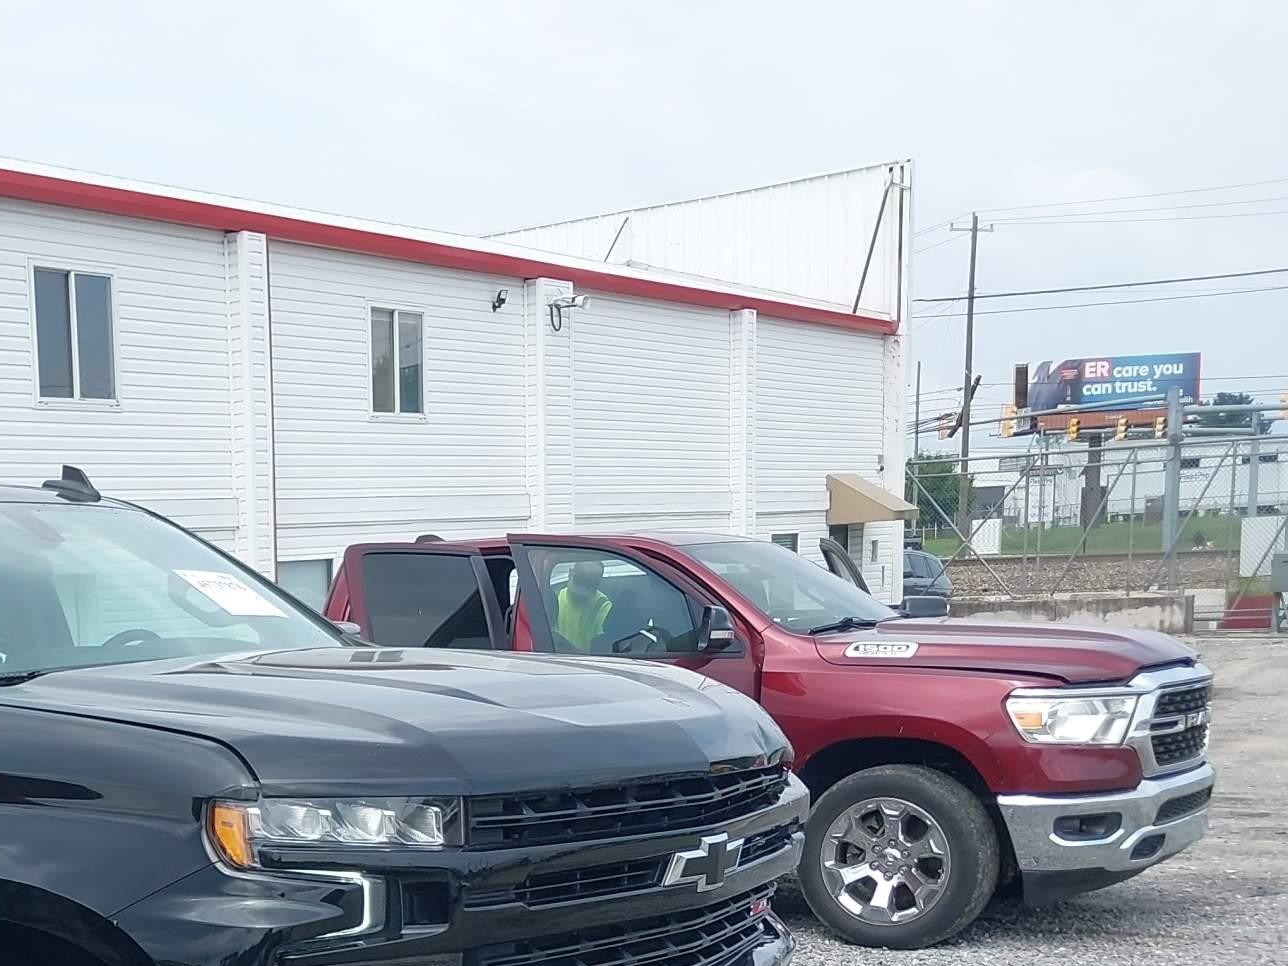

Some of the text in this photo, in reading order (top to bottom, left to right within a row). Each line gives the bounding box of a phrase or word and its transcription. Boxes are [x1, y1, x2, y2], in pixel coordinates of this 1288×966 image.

[1084, 361, 1110, 378] ER
[1113, 365, 1149, 378] care
[1153, 363, 1184, 378] you
[1082, 379, 1158, 395] can trust.
[856, 643, 909, 652] 1500
